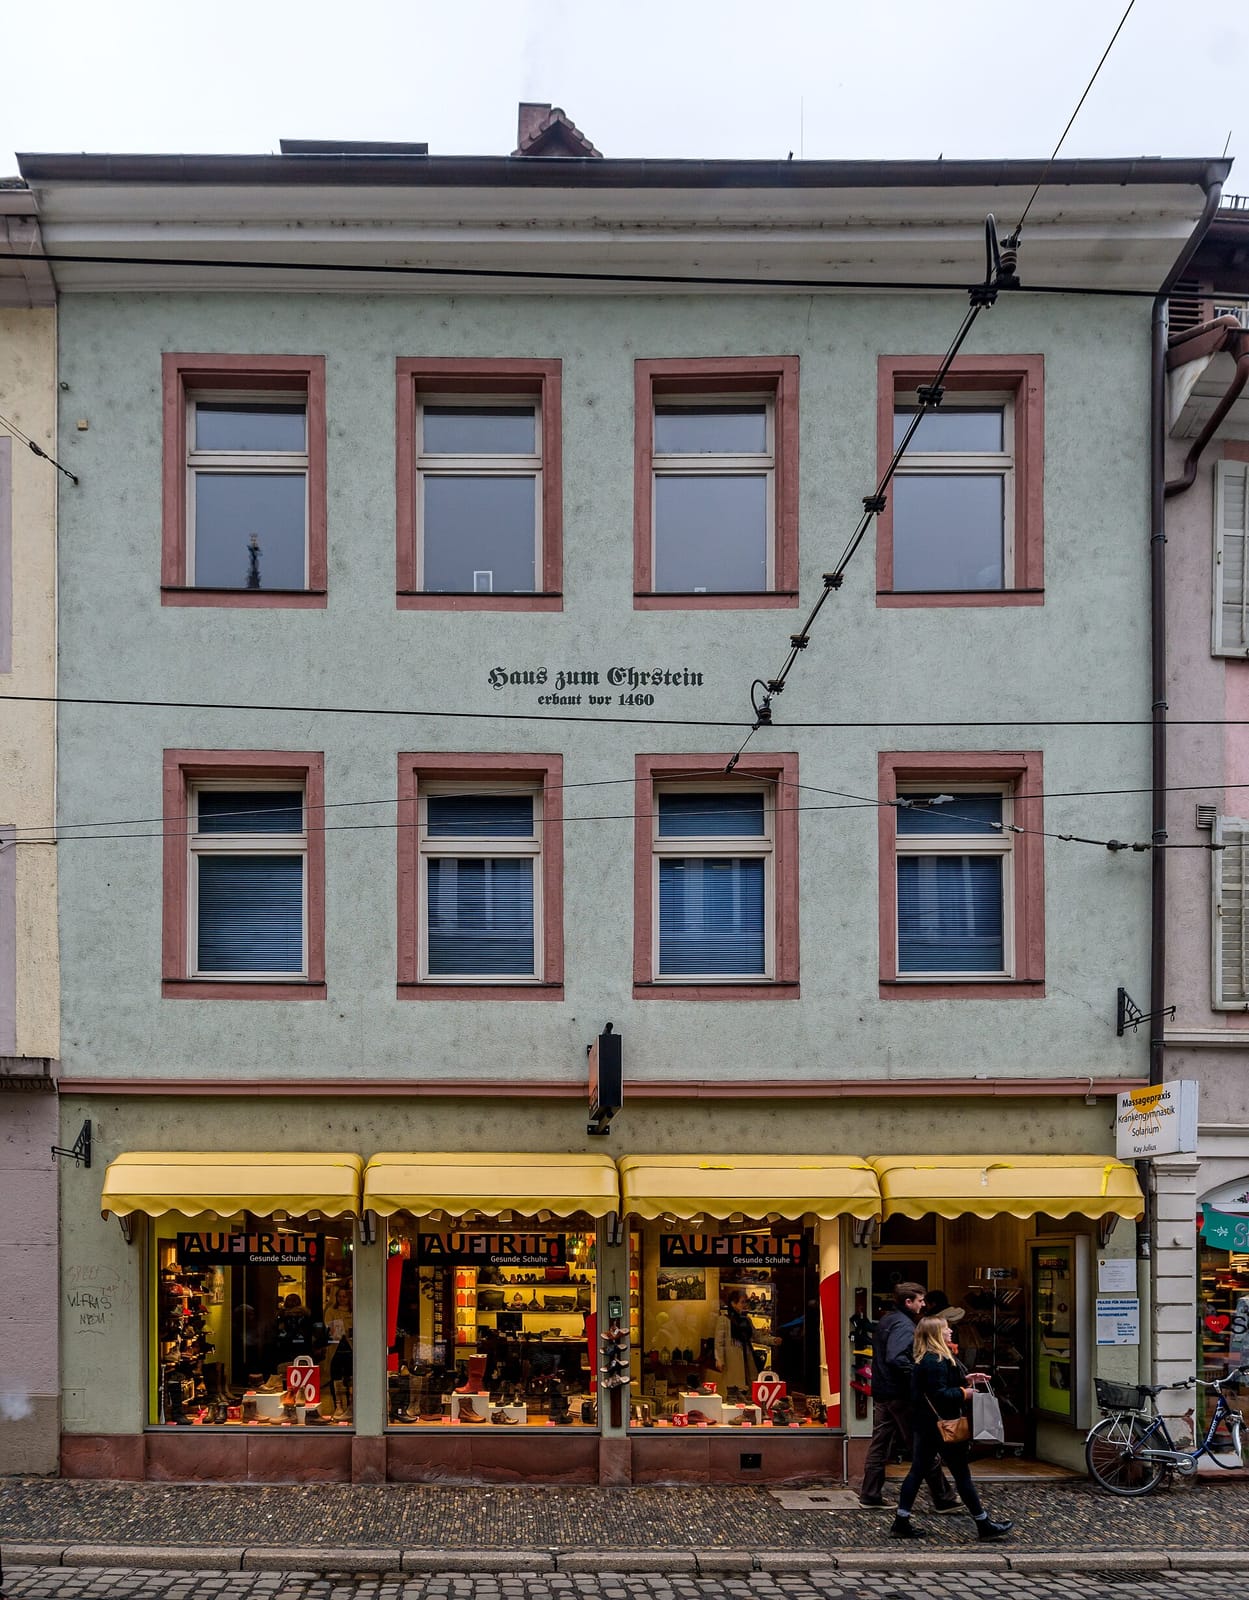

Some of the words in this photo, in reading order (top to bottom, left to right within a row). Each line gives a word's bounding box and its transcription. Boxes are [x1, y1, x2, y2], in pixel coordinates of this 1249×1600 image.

[488, 666, 548, 690] Haus
[555, 671, 600, 690] zum
[606, 666, 704, 691] Ehrstein
[537, 693, 582, 706] erbaut
[588, 693, 612, 706] vor
[617, 693, 655, 706] 1460
[1122, 1090, 1171, 1108] Massagepraxis
[1117, 1105, 1176, 1124] Krankengymnastik
[1131, 1125, 1160, 1137] Solarium
[1133, 1145, 1142, 1154] Kay
[1142, 1144, 1157, 1152] Julius
[249, 1254, 280, 1263] Gesunde
[281, 1254, 307, 1263] Schuhe
[490, 1255, 521, 1263] Gesunde
[522, 1255, 549, 1263] Schuhe
[732, 1256, 763, 1264] Gesunde
[765, 1256, 791, 1264] Schuhe
